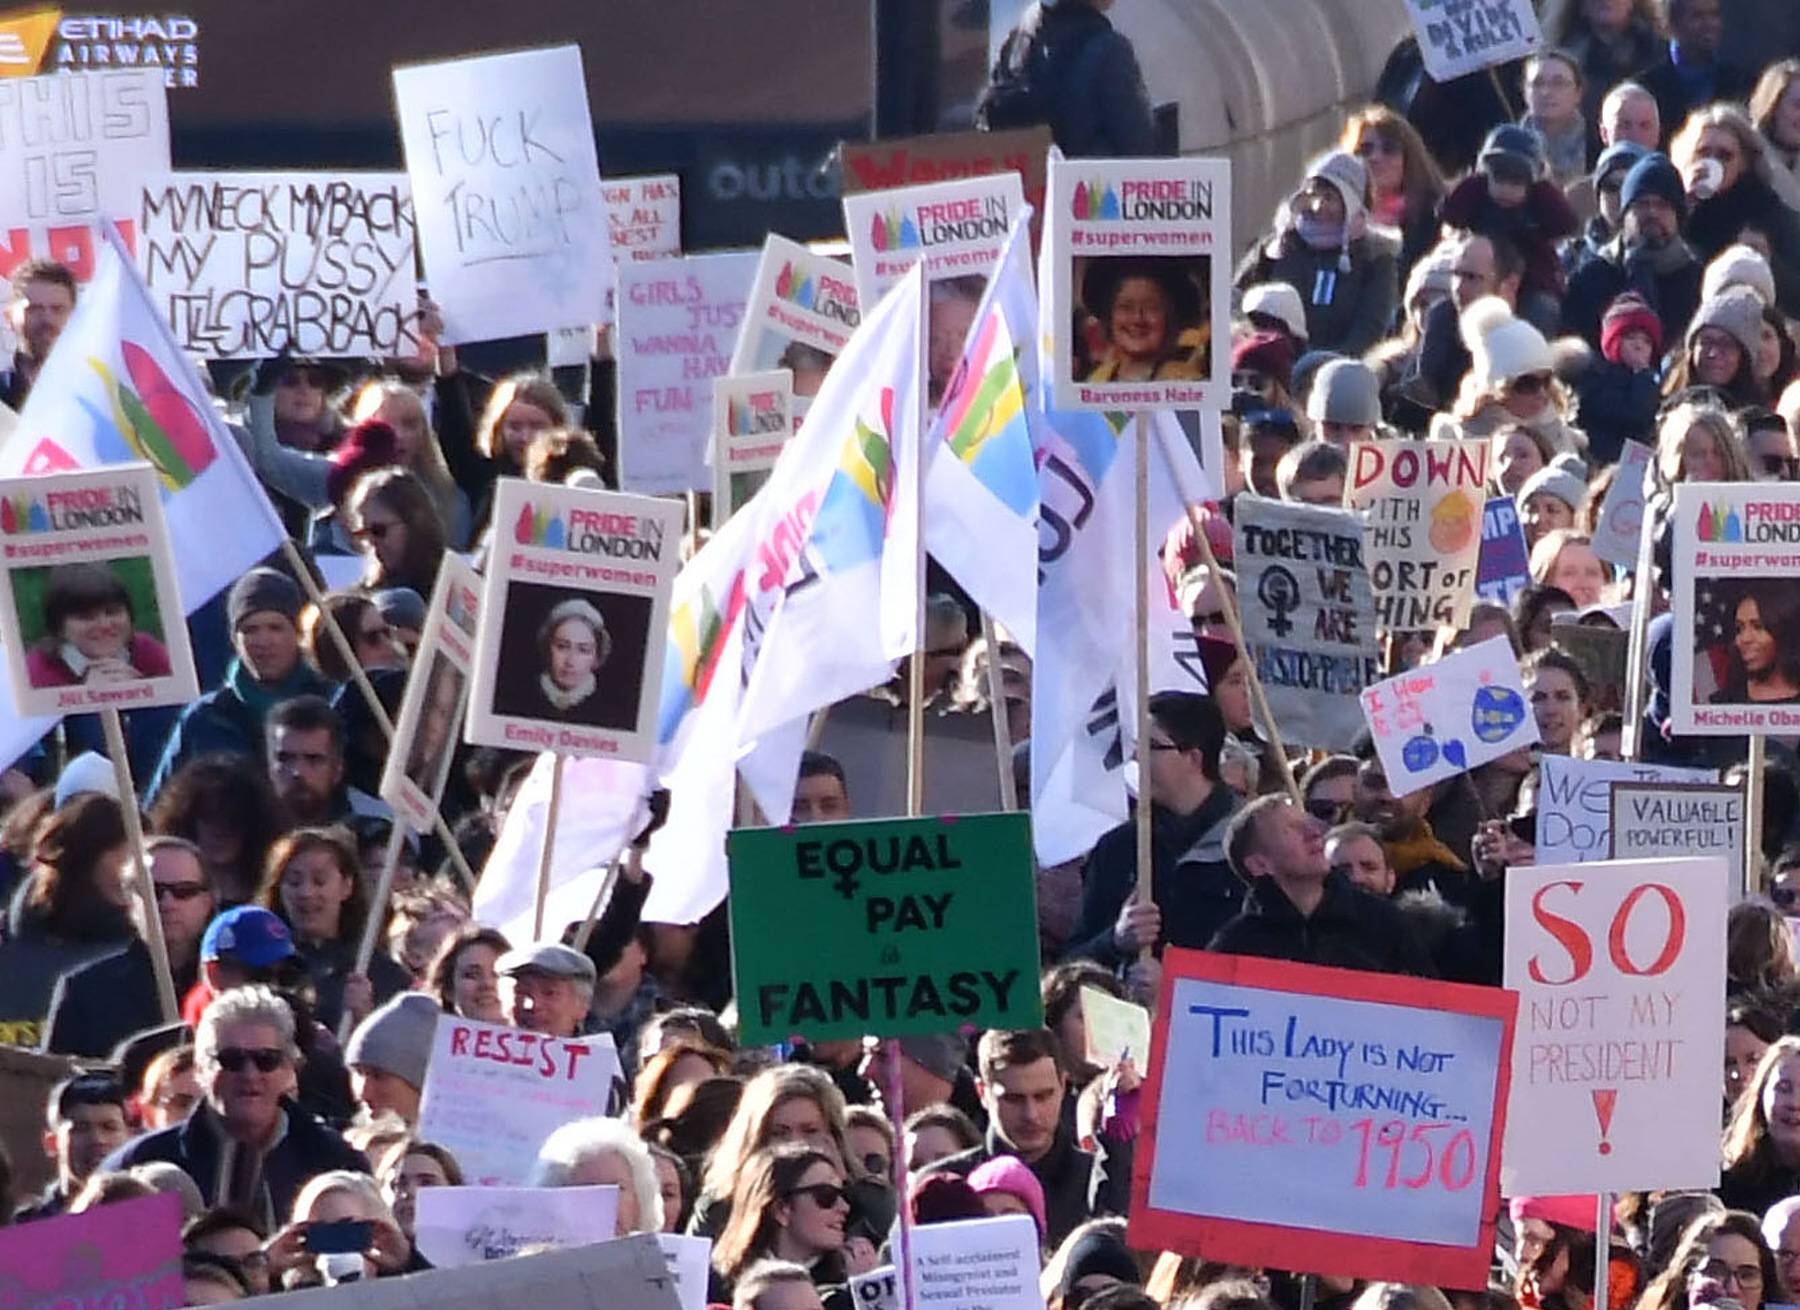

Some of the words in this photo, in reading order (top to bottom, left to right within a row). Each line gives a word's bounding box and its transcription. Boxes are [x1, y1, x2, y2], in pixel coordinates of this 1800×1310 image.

[59, 17, 198, 40] ETIHAD
[58, 45, 198, 64] AIRWAYS
[425, 108, 564, 177] FUCK
[25, 151, 97, 218] IS
[1122, 180, 1185, 200] PRIDE
[1190, 180, 1213, 200] IN
[444, 174, 585, 252] TRUMP
[917, 200, 983, 226] PRIDE
[985, 196, 1007, 214] IN
[1121, 202, 1213, 221] LONDON
[920, 217, 1009, 246] LONDON
[1071, 229, 1213, 247] #superwomen
[146, 234, 217, 290] MY
[245, 228, 412, 295] PUSSY
[629, 276, 703, 304] GIRLS
[635, 389, 693, 412] FUN
[1081, 388, 1160, 404] Baroness
[1166, 388, 1204, 403] Hale
[1353, 444, 1488, 492] DOWN
[46, 491, 111, 510] PRIDE
[115, 486, 141, 504] IN
[51, 503, 143, 528] LONDON
[569, 509, 634, 534] PRIDE
[638, 516, 663, 539] IN
[3, 532, 149, 558] #superwomen
[567, 534, 661, 562] LONDON
[1242, 525, 1365, 569] TOGETHER
[510, 554, 657, 587] #superwomen
[1316, 566, 1353, 602] WE
[1314, 608, 1361, 644] ARE
[1694, 711, 1765, 727] Michelle
[505, 724, 554, 746] Emily
[559, 732, 618, 752] Davies
[1633, 797, 1739, 824] VALUABLE
[1628, 827, 1733, 849] POWERFUL!
[795, 834, 961, 892] EQUAL
[866, 892, 953, 934] PAY
[1528, 881, 1686, 985] SO
[757, 969, 1020, 1029] FANTASY
[1530, 997, 1602, 1031] NOT
[1631, 993, 1680, 1027] MY
[451, 1027, 590, 1080] RESIST
[1189, 1006, 1274, 1058] THIS
[1363, 1043, 1388, 1066] IS
[1397, 1046, 1454, 1073] NOT
[1529, 1039, 1684, 1087] PRESIDENT
[1206, 1109, 1296, 1145] BACK
[1304, 1117, 1344, 1146] TO
[1350, 1118, 1477, 1192] 1950
